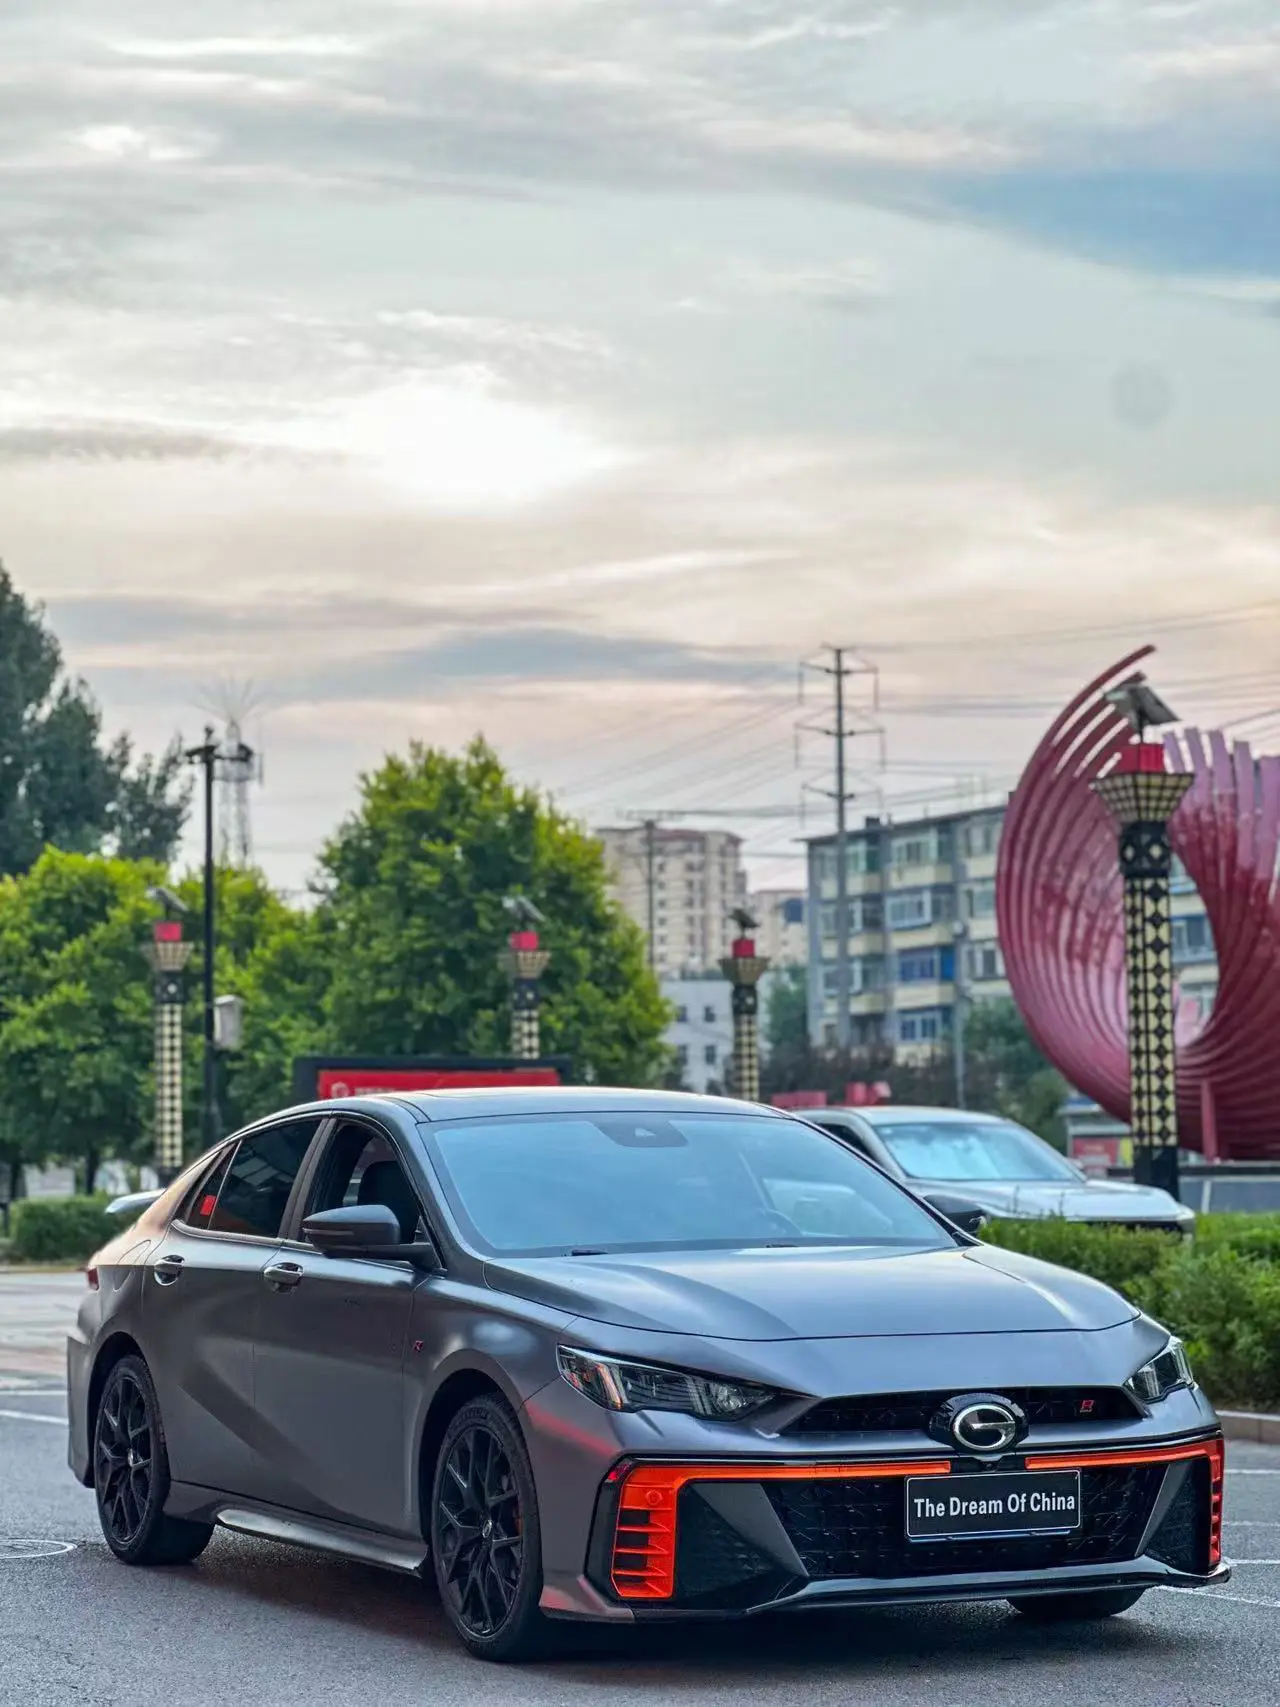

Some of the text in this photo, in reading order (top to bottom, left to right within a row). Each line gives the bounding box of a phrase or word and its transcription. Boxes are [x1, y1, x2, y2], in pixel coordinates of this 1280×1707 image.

[914, 1492, 1075, 1518] The Dream Of China
